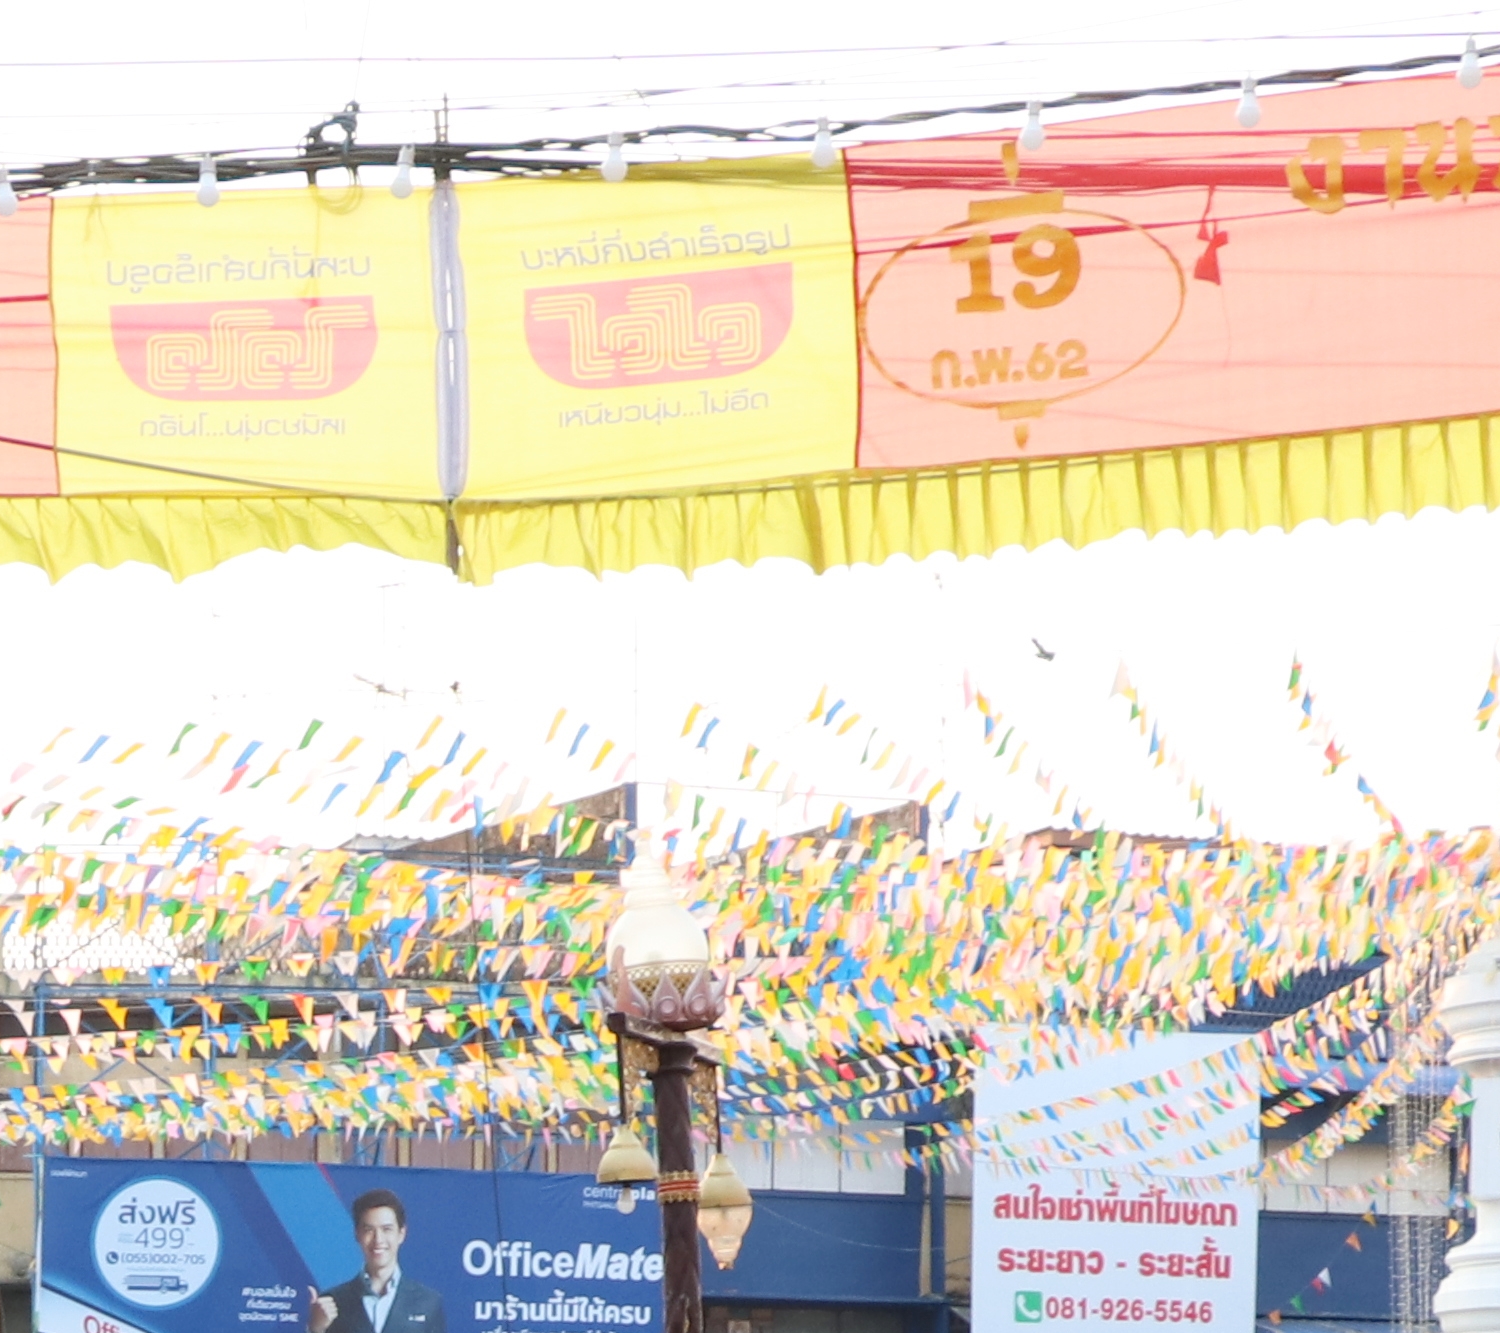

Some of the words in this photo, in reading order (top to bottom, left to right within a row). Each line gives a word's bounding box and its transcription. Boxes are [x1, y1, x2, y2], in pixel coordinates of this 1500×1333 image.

[521, 223, 792, 271] บะหมี่กึ่งสำเร็จรูป
[949, 222, 1083, 314] 19
[930, 338, 1089, 389] ก.พ.62
[118, 1197, 195, 1225] ส่งฟรี
[993, 1181, 1238, 1227] สนใจเช่าพื้นที่โฆษณา
[463, 1238, 664, 1281] OfficeMate
[998, 1248, 1104, 1275] ระยะยาว
[1139, 1236, 1231, 1279] ระยะสั้น
[475, 1289, 652, 1325] มาร้านนี้มีให้ครบ
[1045, 1297, 1213, 1323] 081-926-5546
